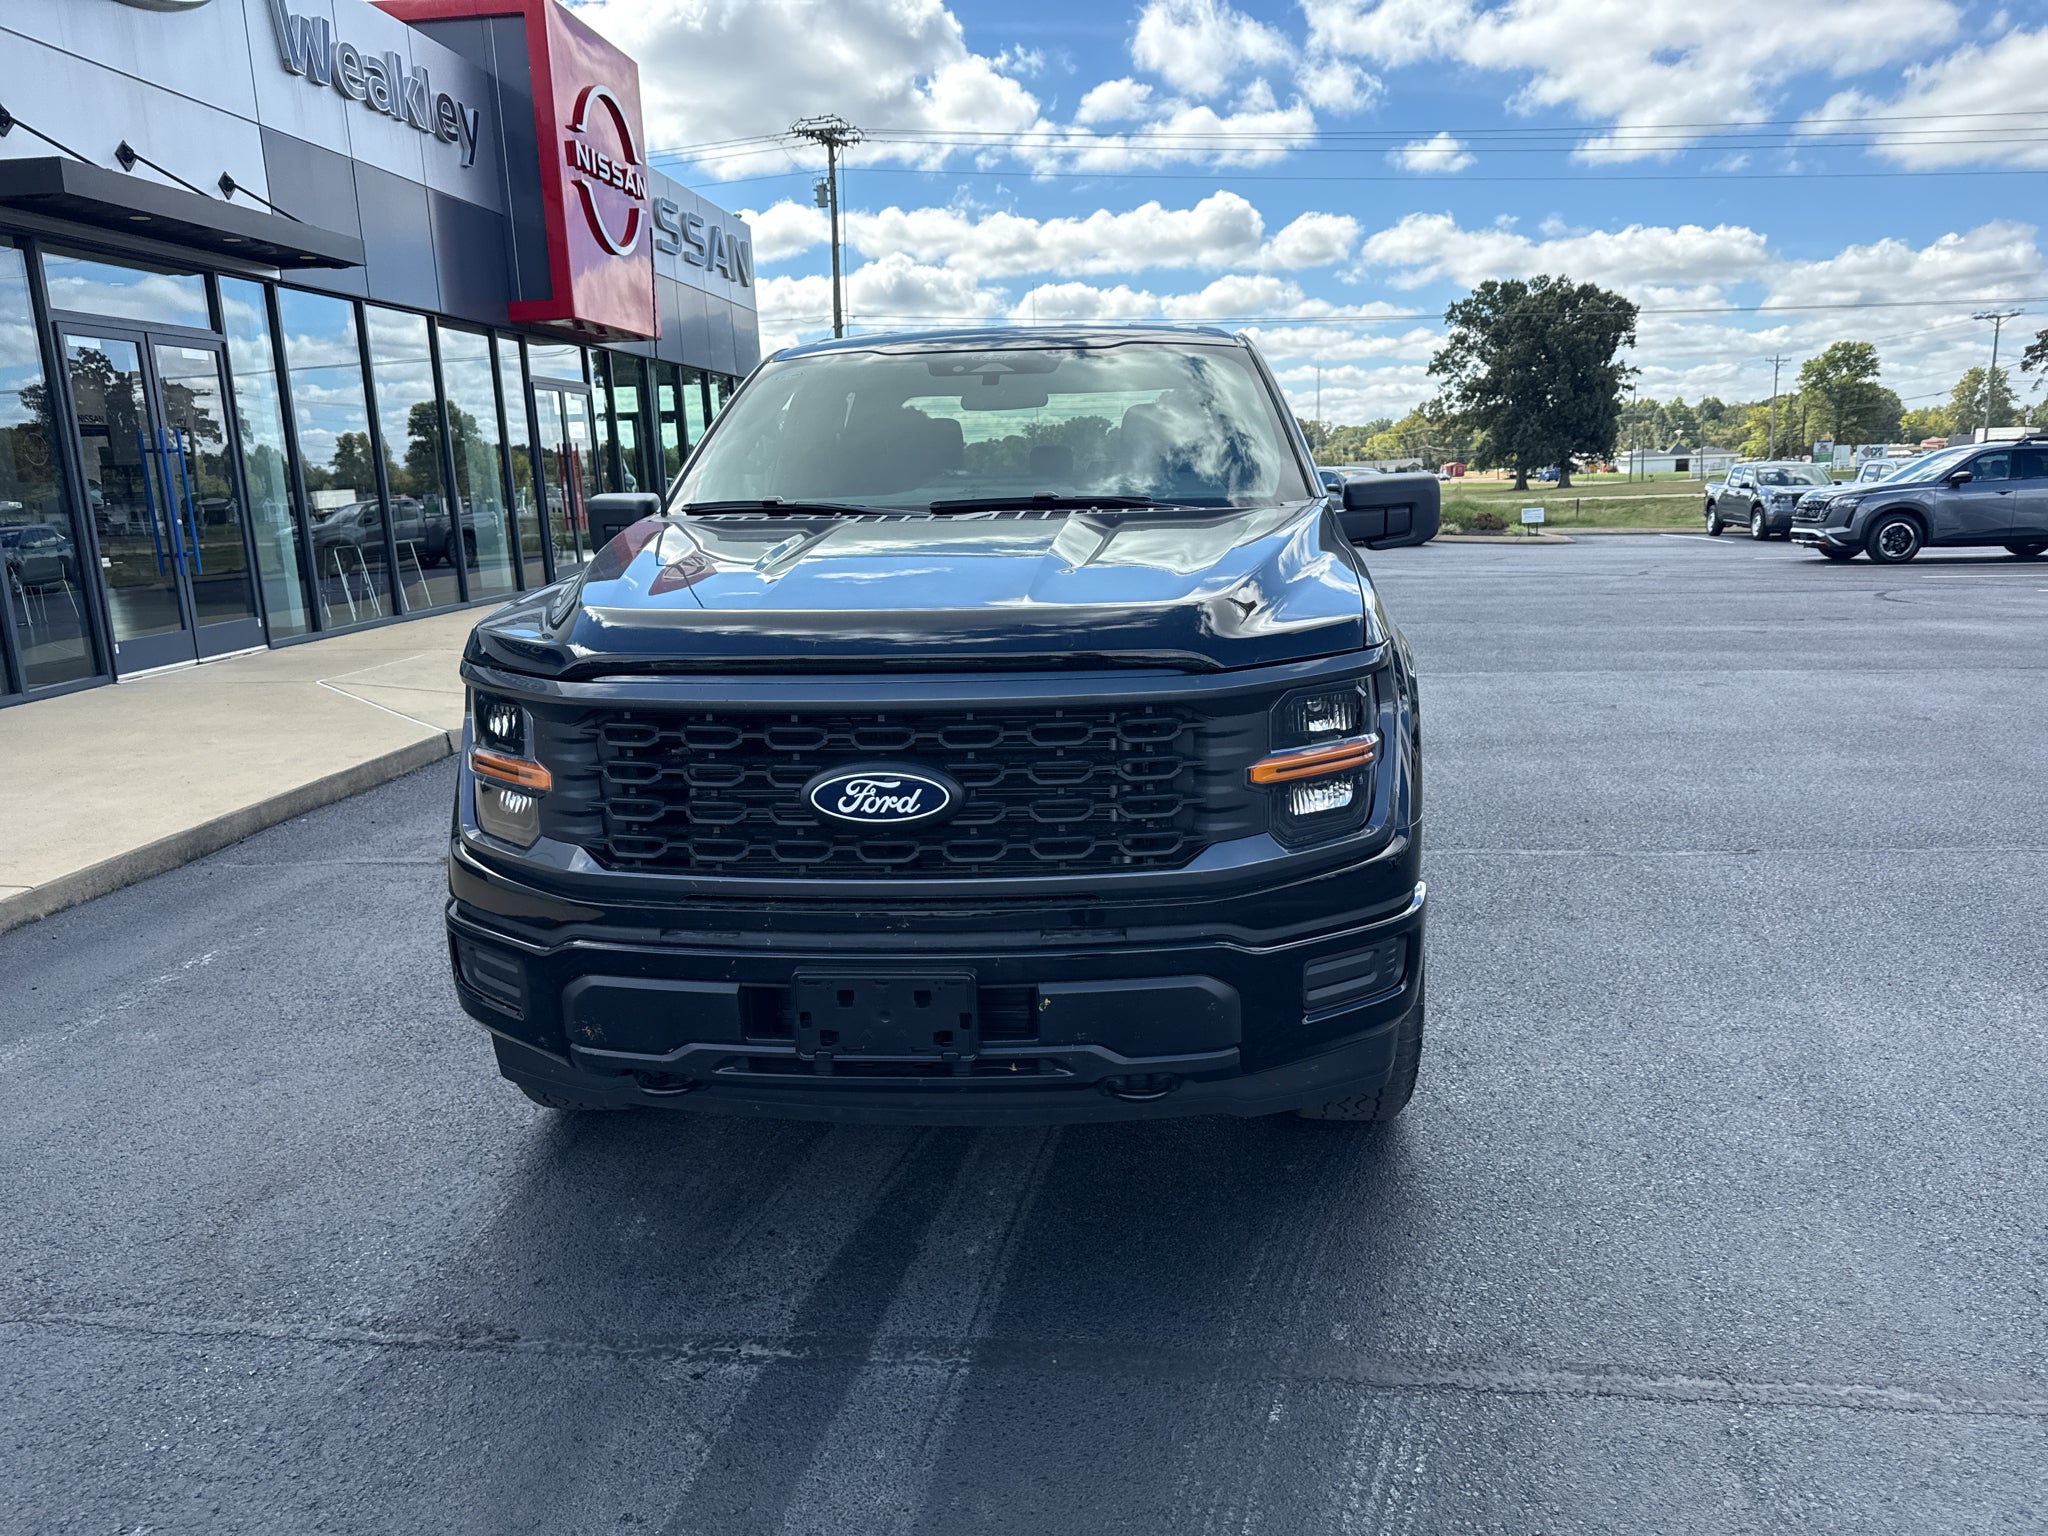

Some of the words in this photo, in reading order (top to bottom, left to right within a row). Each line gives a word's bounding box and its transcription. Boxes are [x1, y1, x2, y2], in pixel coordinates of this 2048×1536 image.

[270, 0, 480, 168] Weakley
[566, 139, 647, 200] NISSAN
[654, 197, 750, 288] SSAN
[837, 779, 923, 814] Ford
